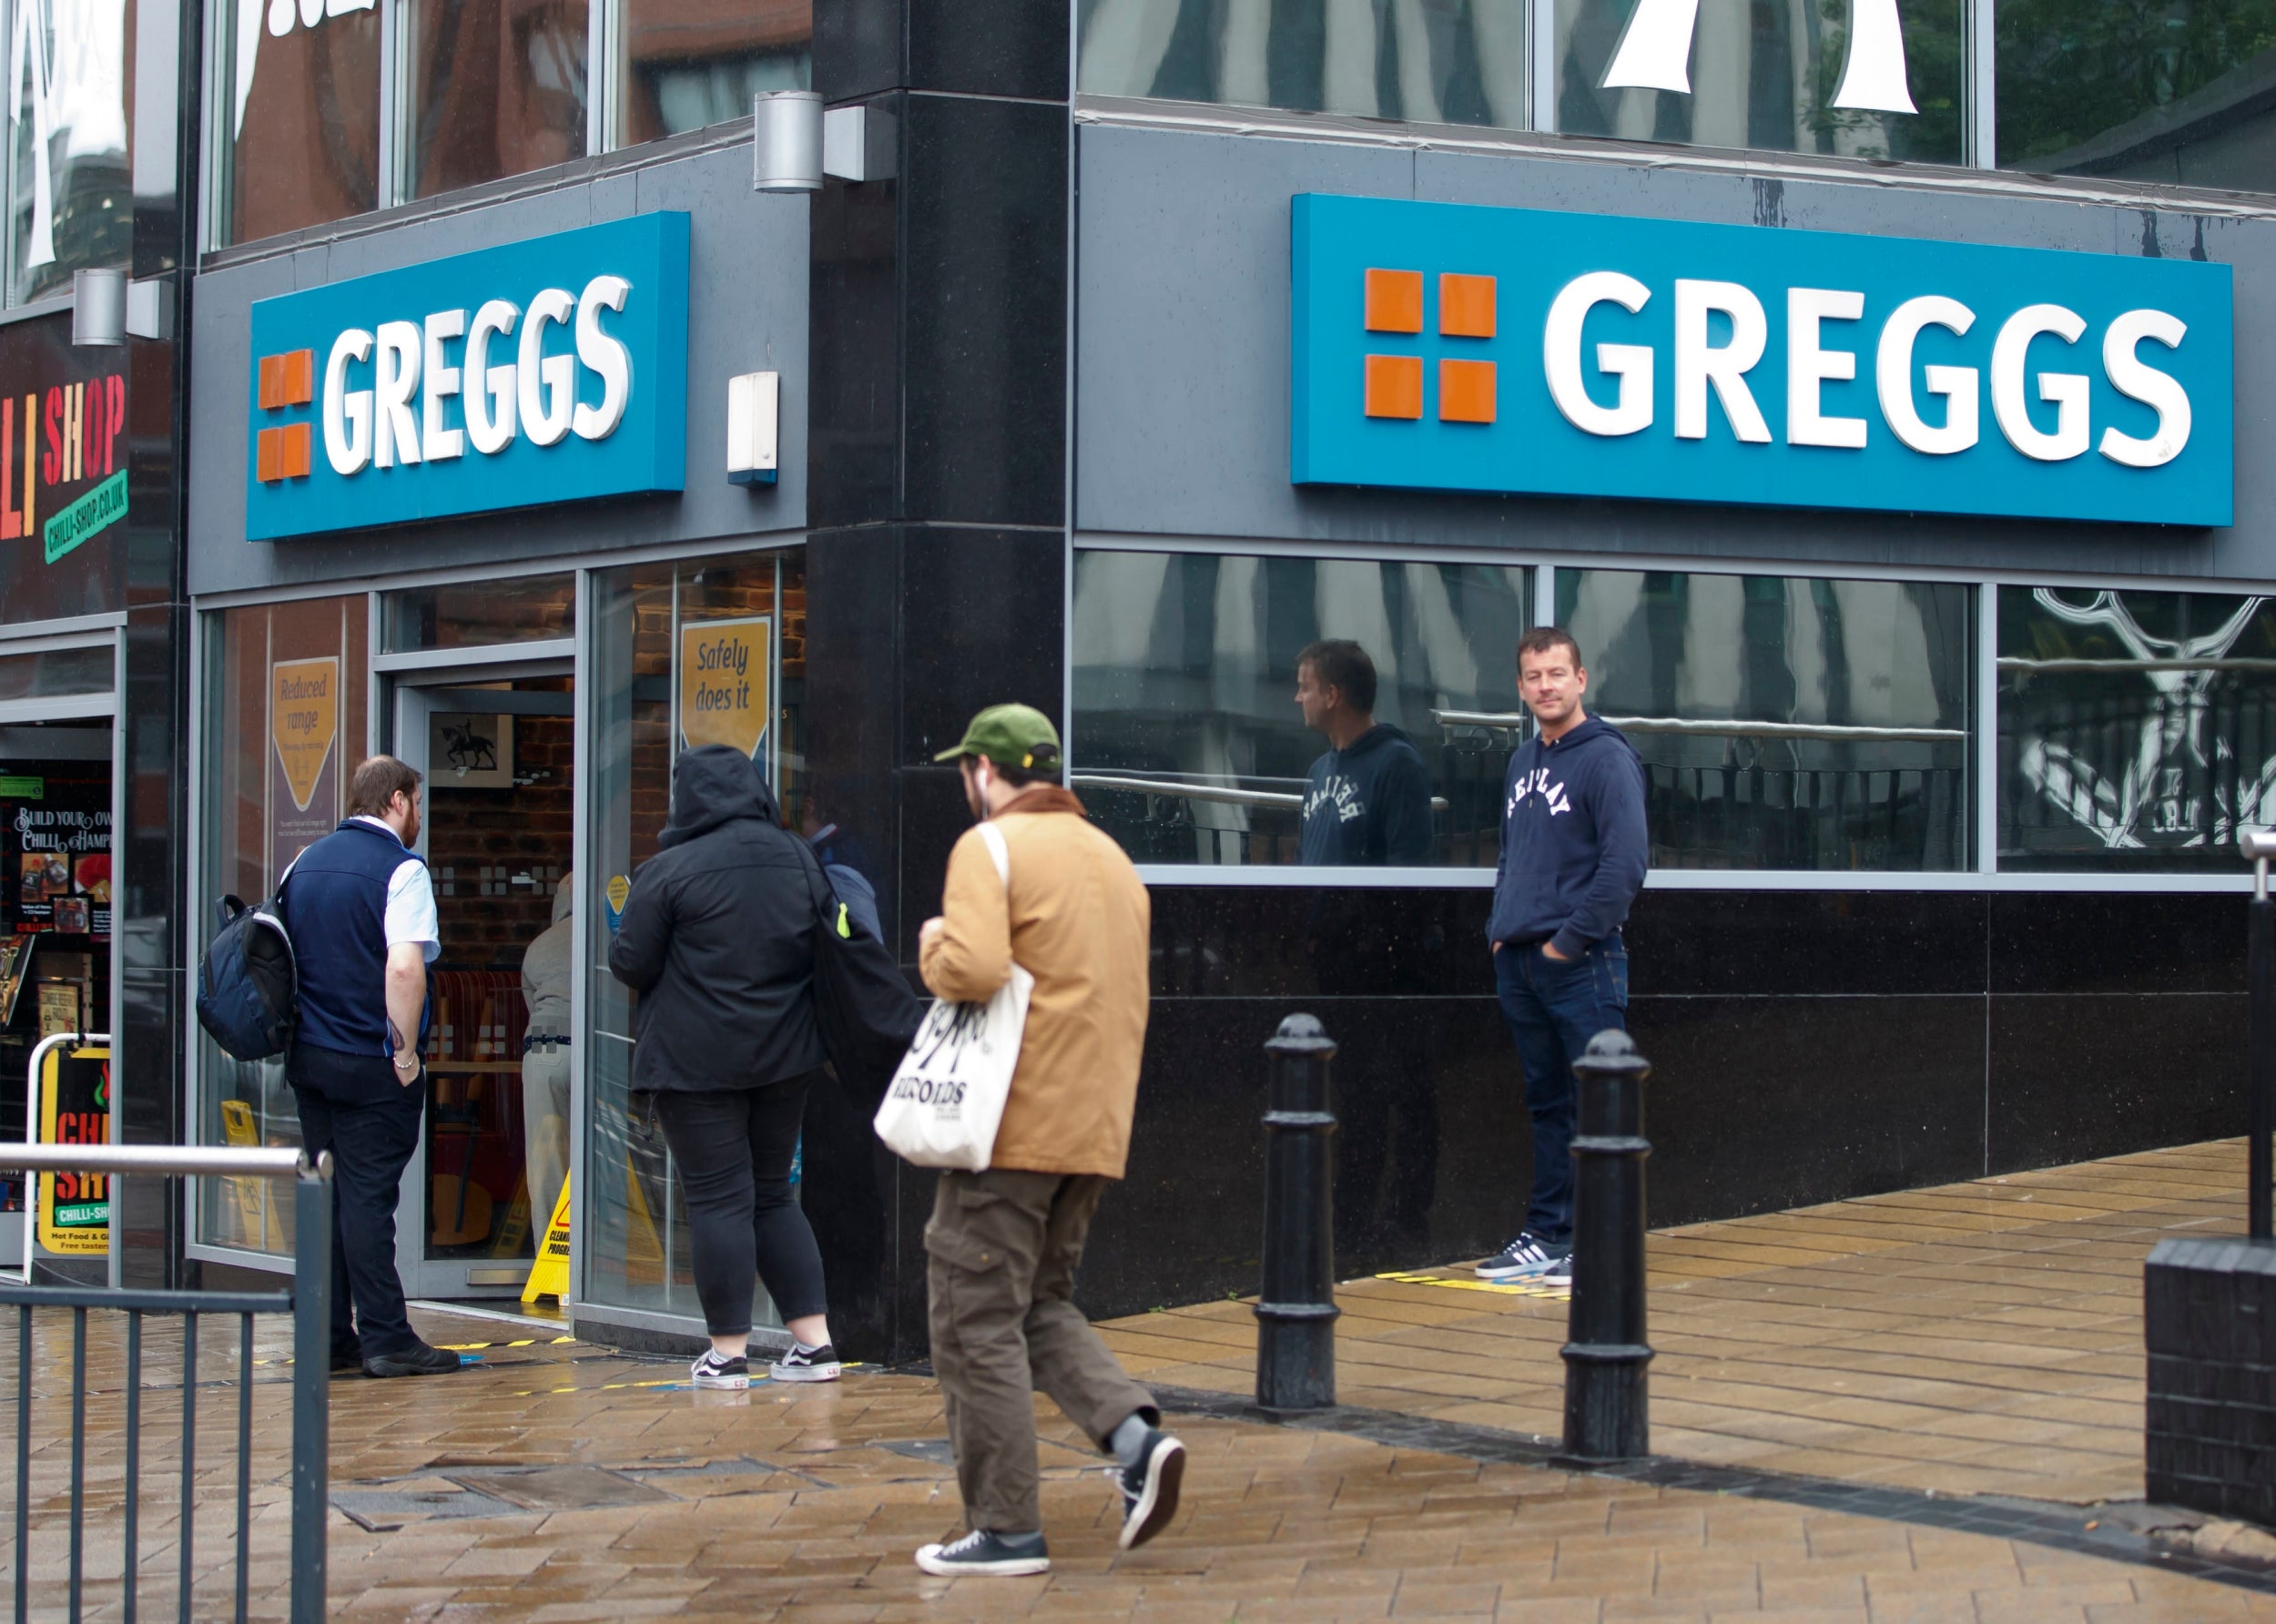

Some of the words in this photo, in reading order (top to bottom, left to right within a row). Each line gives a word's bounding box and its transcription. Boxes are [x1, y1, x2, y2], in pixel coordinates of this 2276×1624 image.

[323, 275, 631, 476] GREGGS
[1544, 270, 2192, 468] GREGGS
[43, 374, 125, 486] SHOP
[48, 479, 124, 553] CHILLI-SHOP.CO.UK
[697, 637, 749, 676] Safely
[280, 673, 327, 701] Reduced
[696, 681, 732, 712] does
[736, 679, 750, 710] it
[287, 709, 319, 736] range
[56, 1170, 110, 1199] SH
